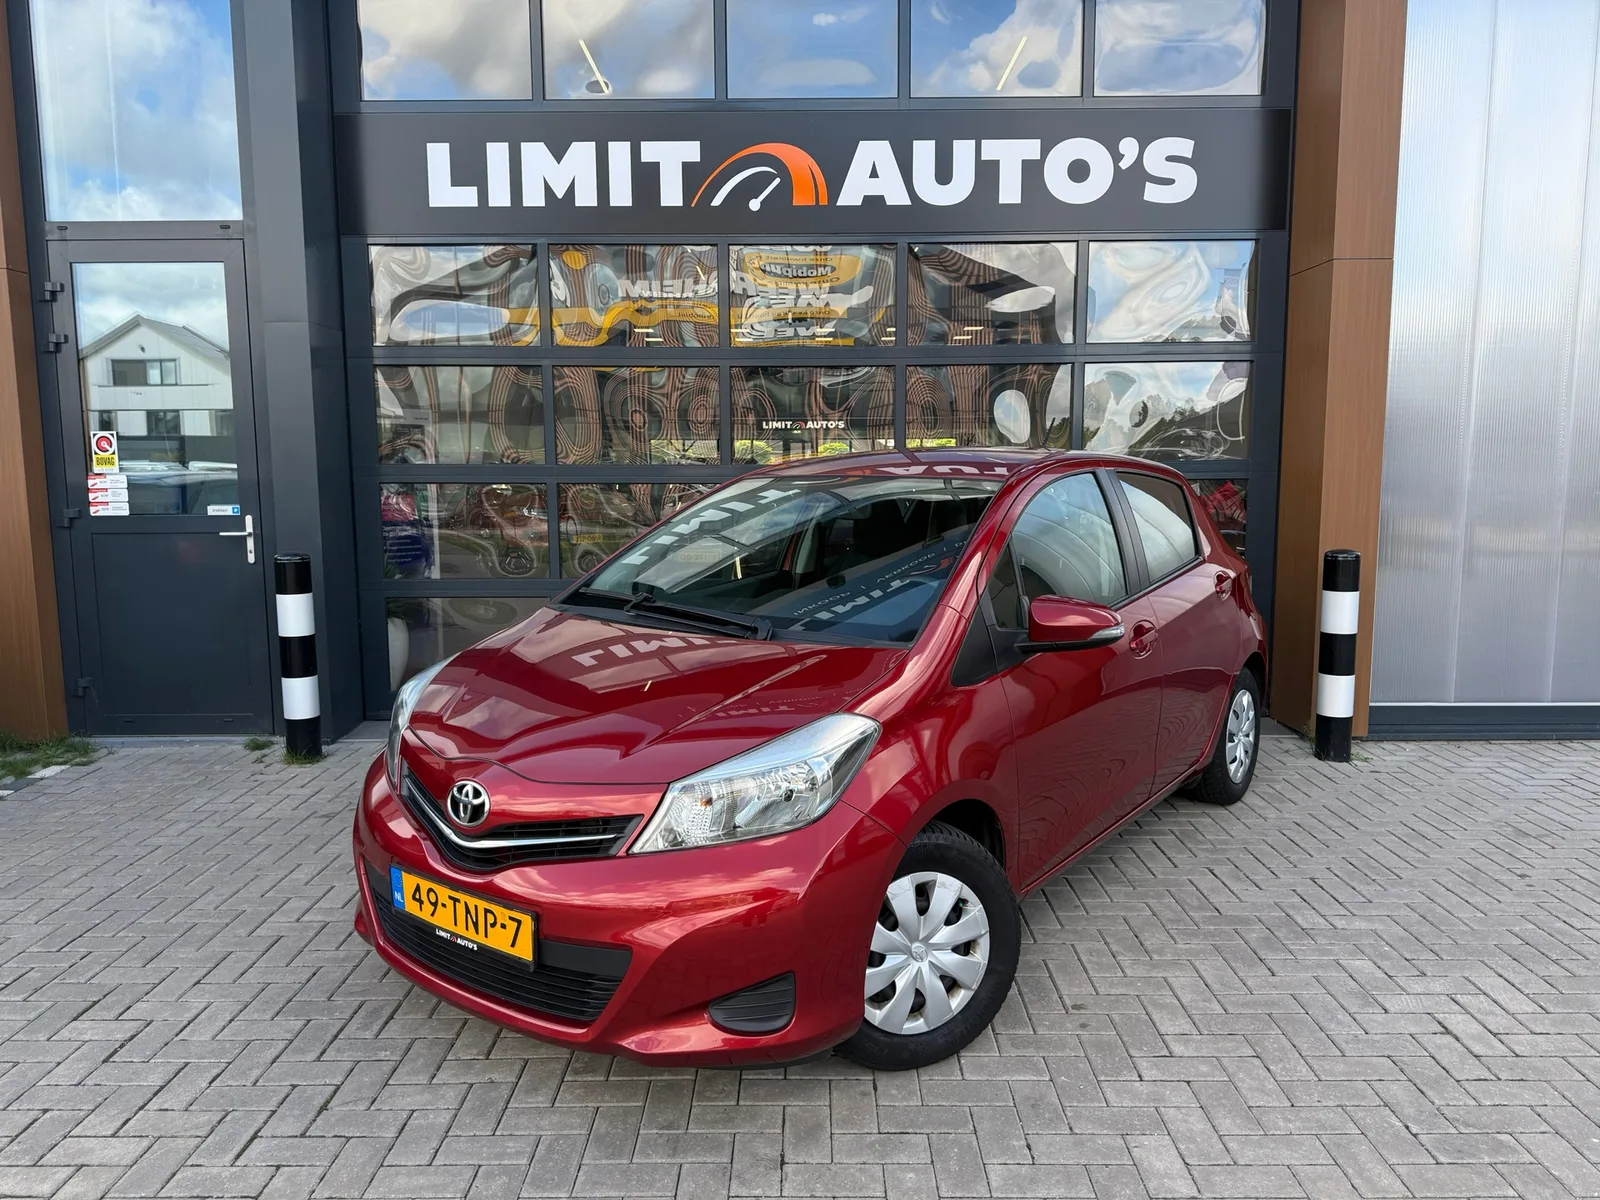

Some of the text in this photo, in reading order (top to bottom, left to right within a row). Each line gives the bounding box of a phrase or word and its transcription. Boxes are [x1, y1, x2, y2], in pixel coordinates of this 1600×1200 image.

[426, 137, 1198, 207] LIMIT AUTO'S
[762, 420, 845, 429] LIMIT AUTO'S
[96, 456, 115, 466] BOVAG
[394, 882, 523, 949] NL 49-TNP-7
[435, 928, 478, 951] LIMIT AUTO'S
